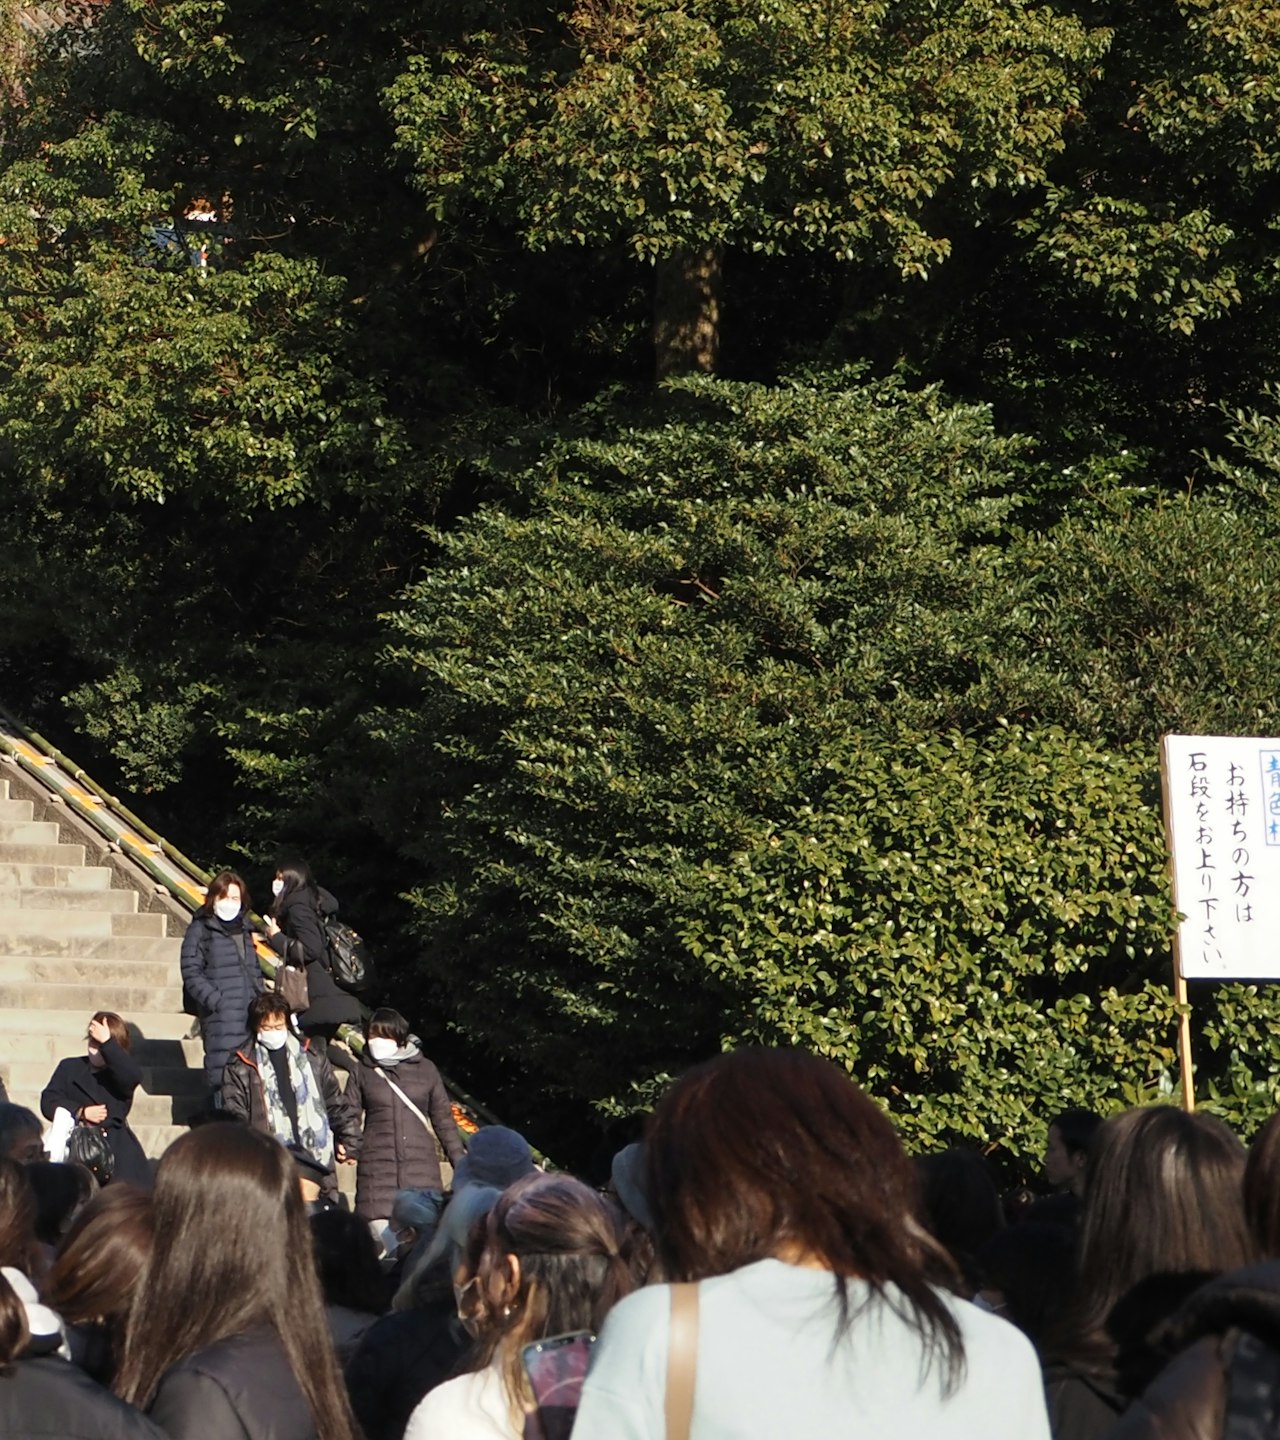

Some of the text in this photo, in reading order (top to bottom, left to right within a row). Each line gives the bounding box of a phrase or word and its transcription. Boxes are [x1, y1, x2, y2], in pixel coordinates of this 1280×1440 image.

[1225, 761, 1255, 923] お持ちの方は
